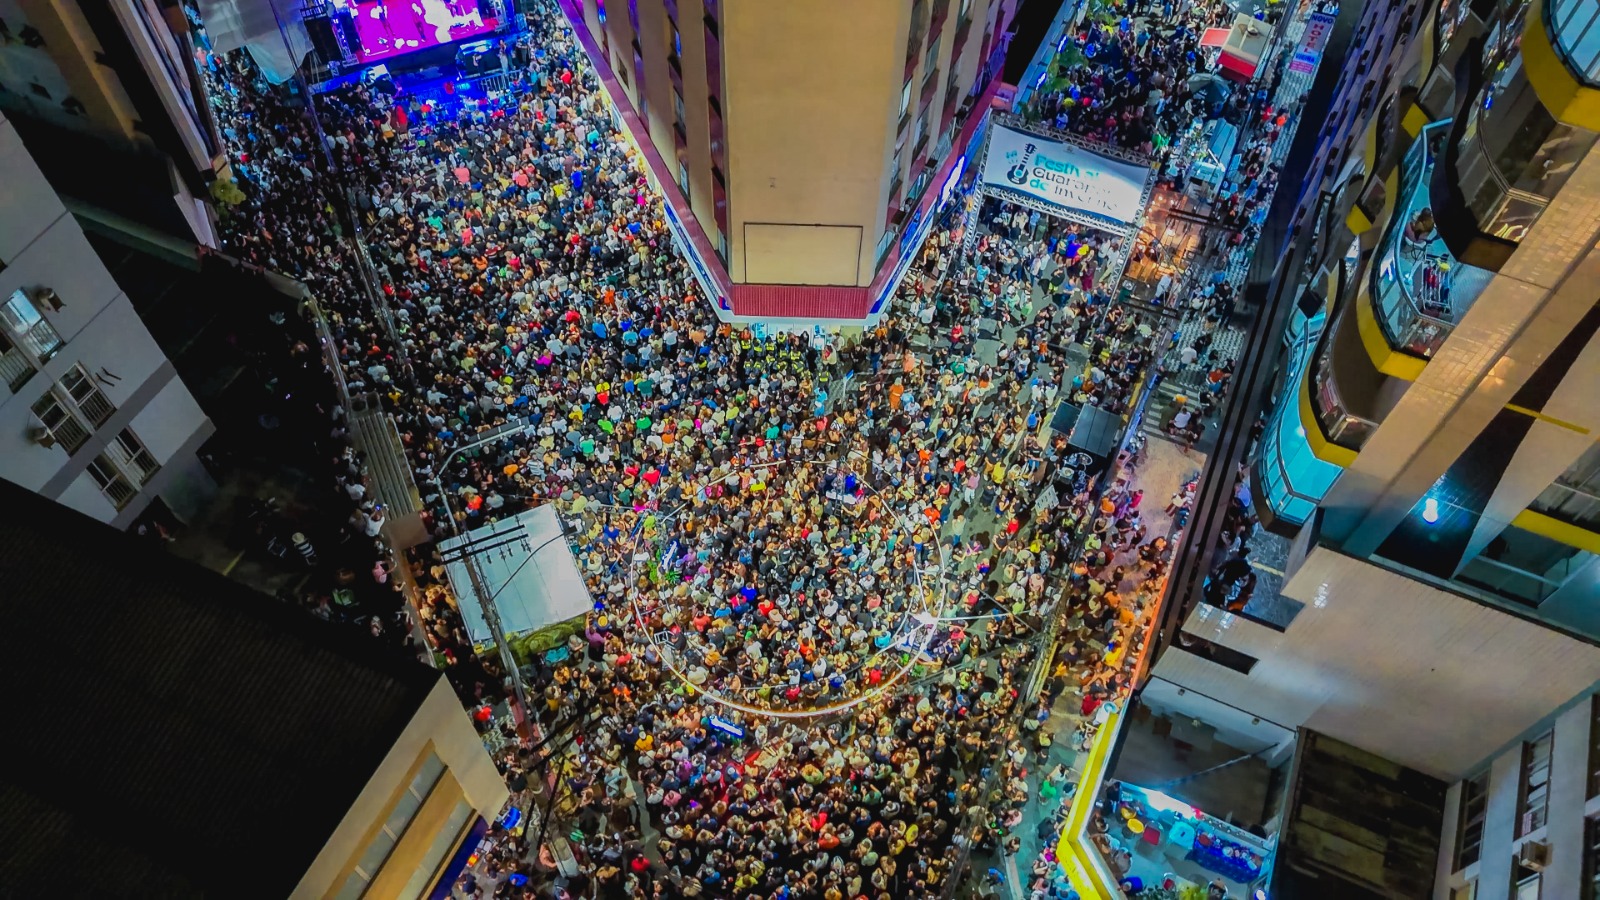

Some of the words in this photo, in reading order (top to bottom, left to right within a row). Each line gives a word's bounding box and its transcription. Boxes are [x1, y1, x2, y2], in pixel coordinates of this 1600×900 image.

[1312, 15, 1333, 24] NOVO
[1304, 24, 1324, 53] HOTEL
[1032, 167, 1111, 195] Guara
